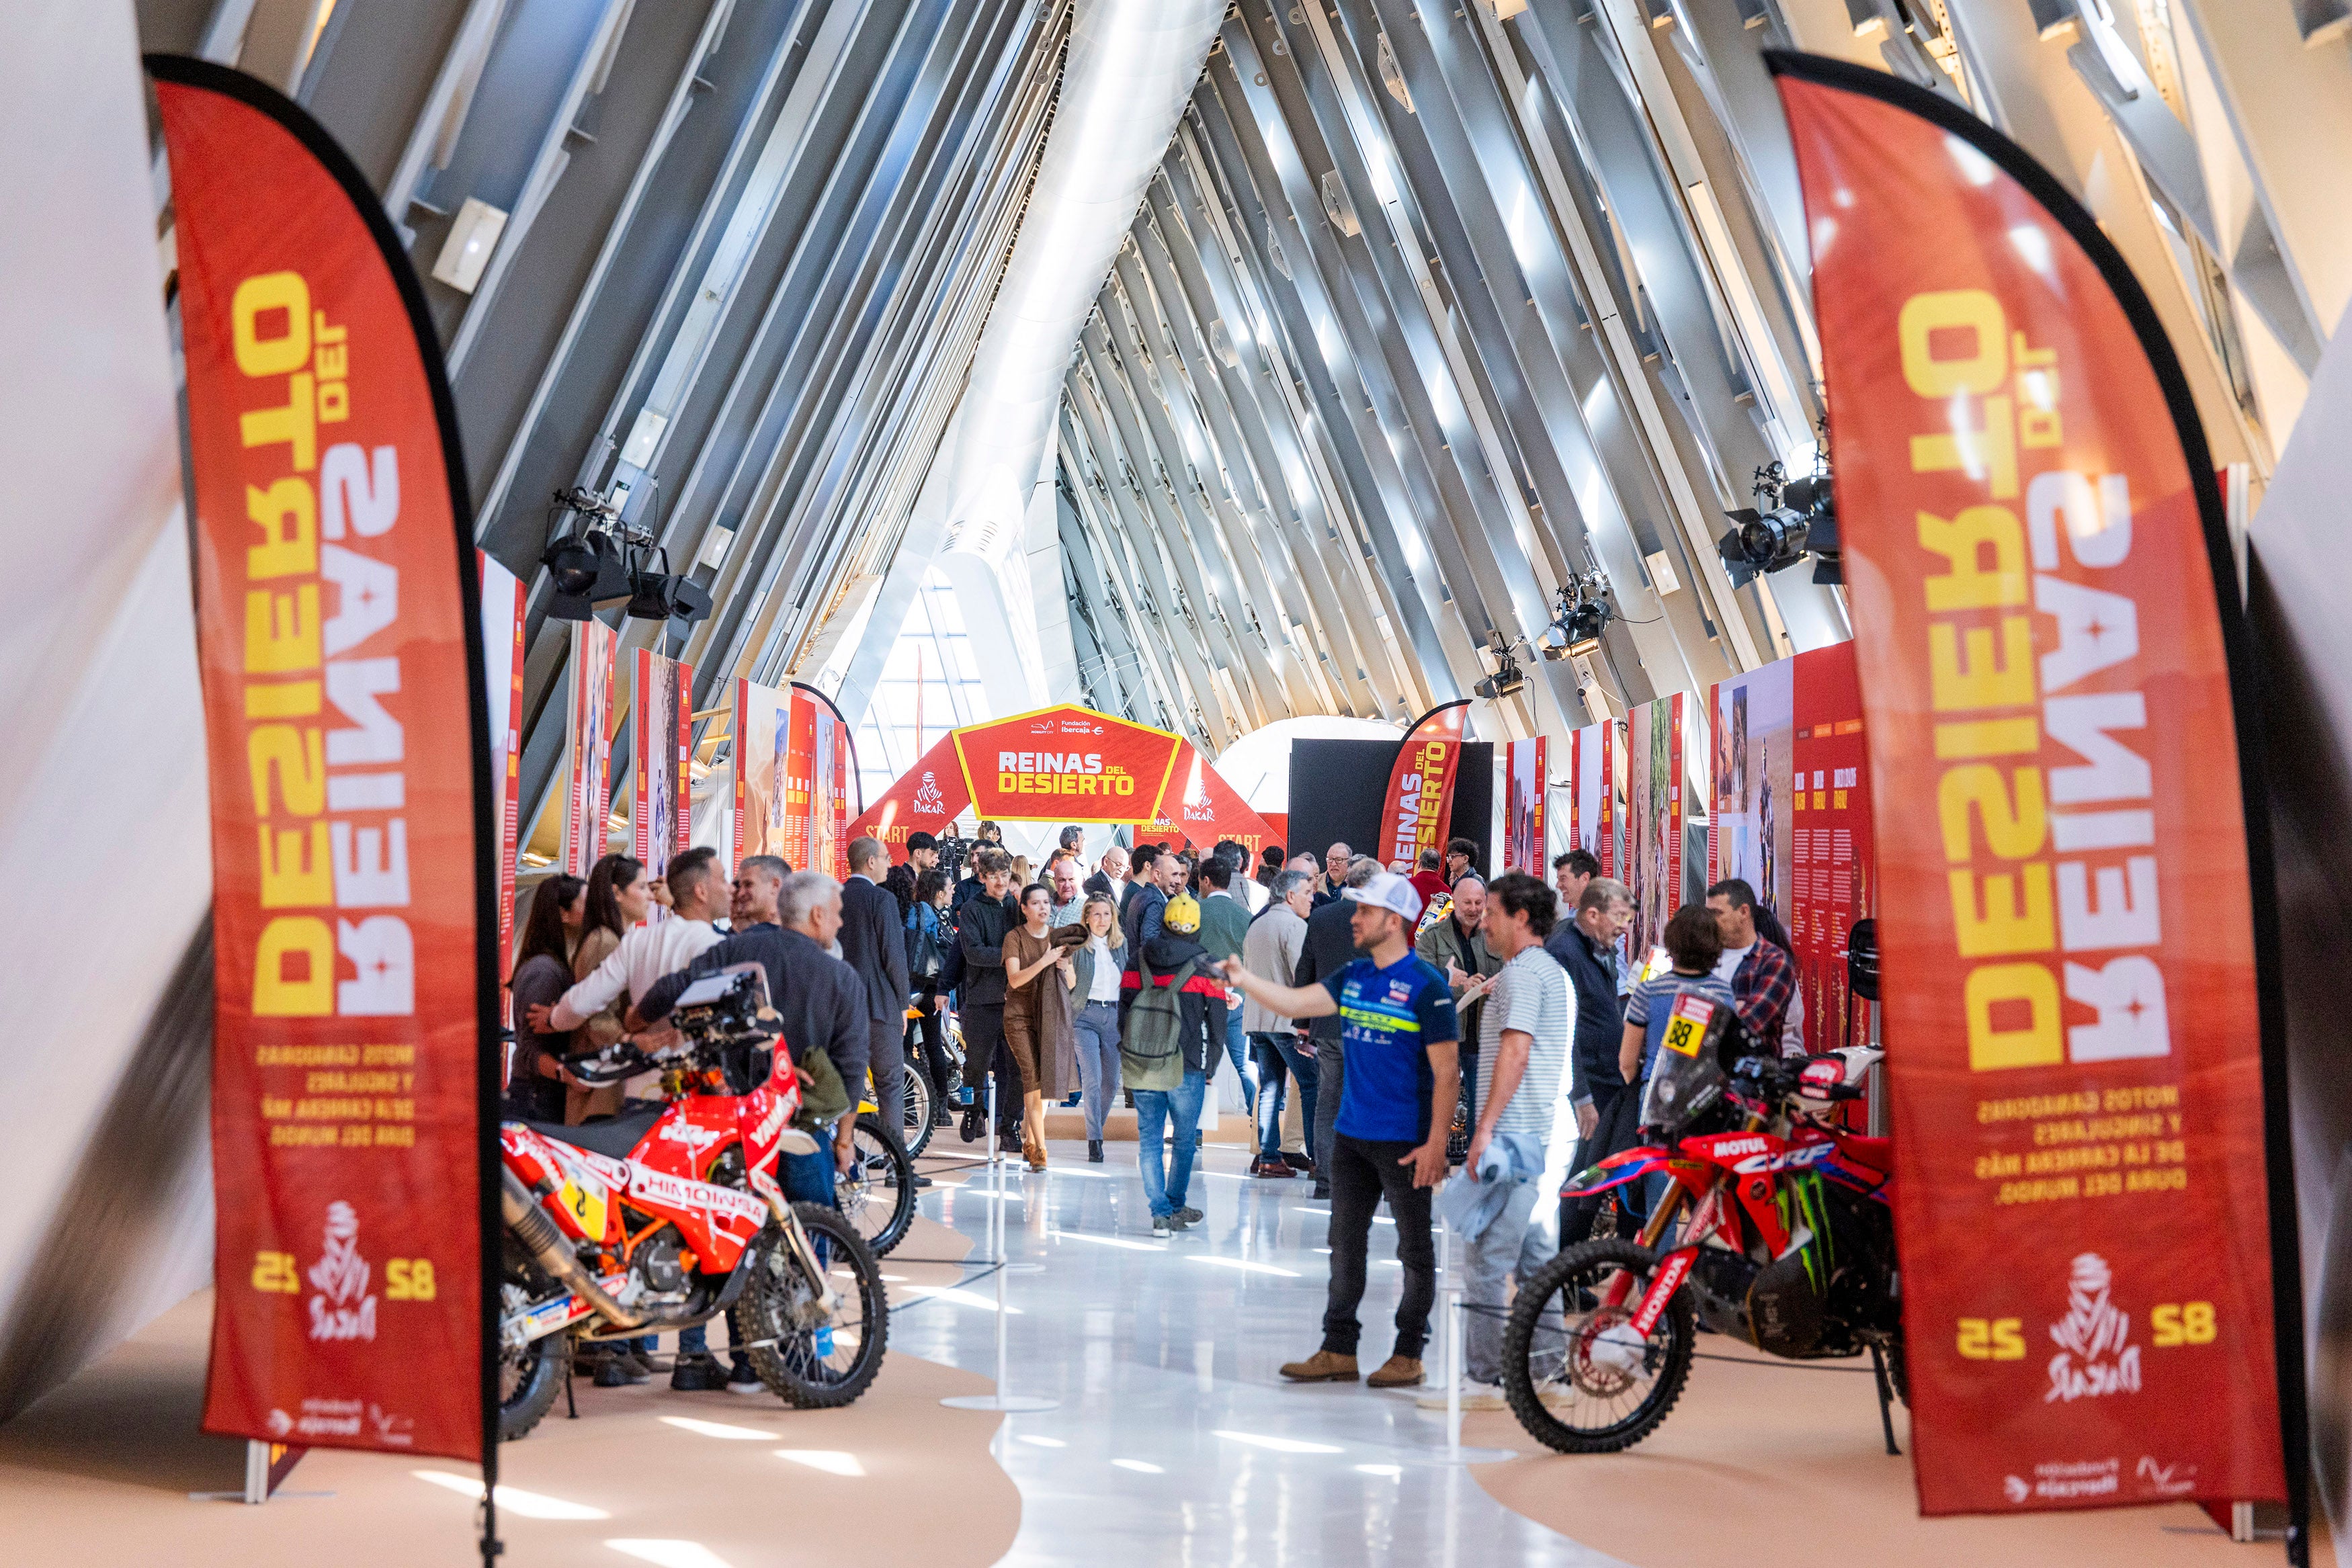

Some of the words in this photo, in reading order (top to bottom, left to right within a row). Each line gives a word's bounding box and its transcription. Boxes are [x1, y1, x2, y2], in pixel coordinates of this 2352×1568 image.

[999, 751, 1102, 774] REINAS
[1105, 766, 1126, 775] DEL
[1415, 749, 1425, 769] DEL
[999, 773, 1134, 795] DESIERTO
[914, 799, 945, 814] DAKAR
[1183, 807, 1215, 822] DAKAR
[1141, 825, 1179, 833] DESIERTO
[1153, 818, 1171, 826] NAS
[1714, 1137, 1768, 1158] MOTUL
[648, 1176, 762, 1219] HIMOINSA
[1636, 1257, 1688, 1333] HONDA
